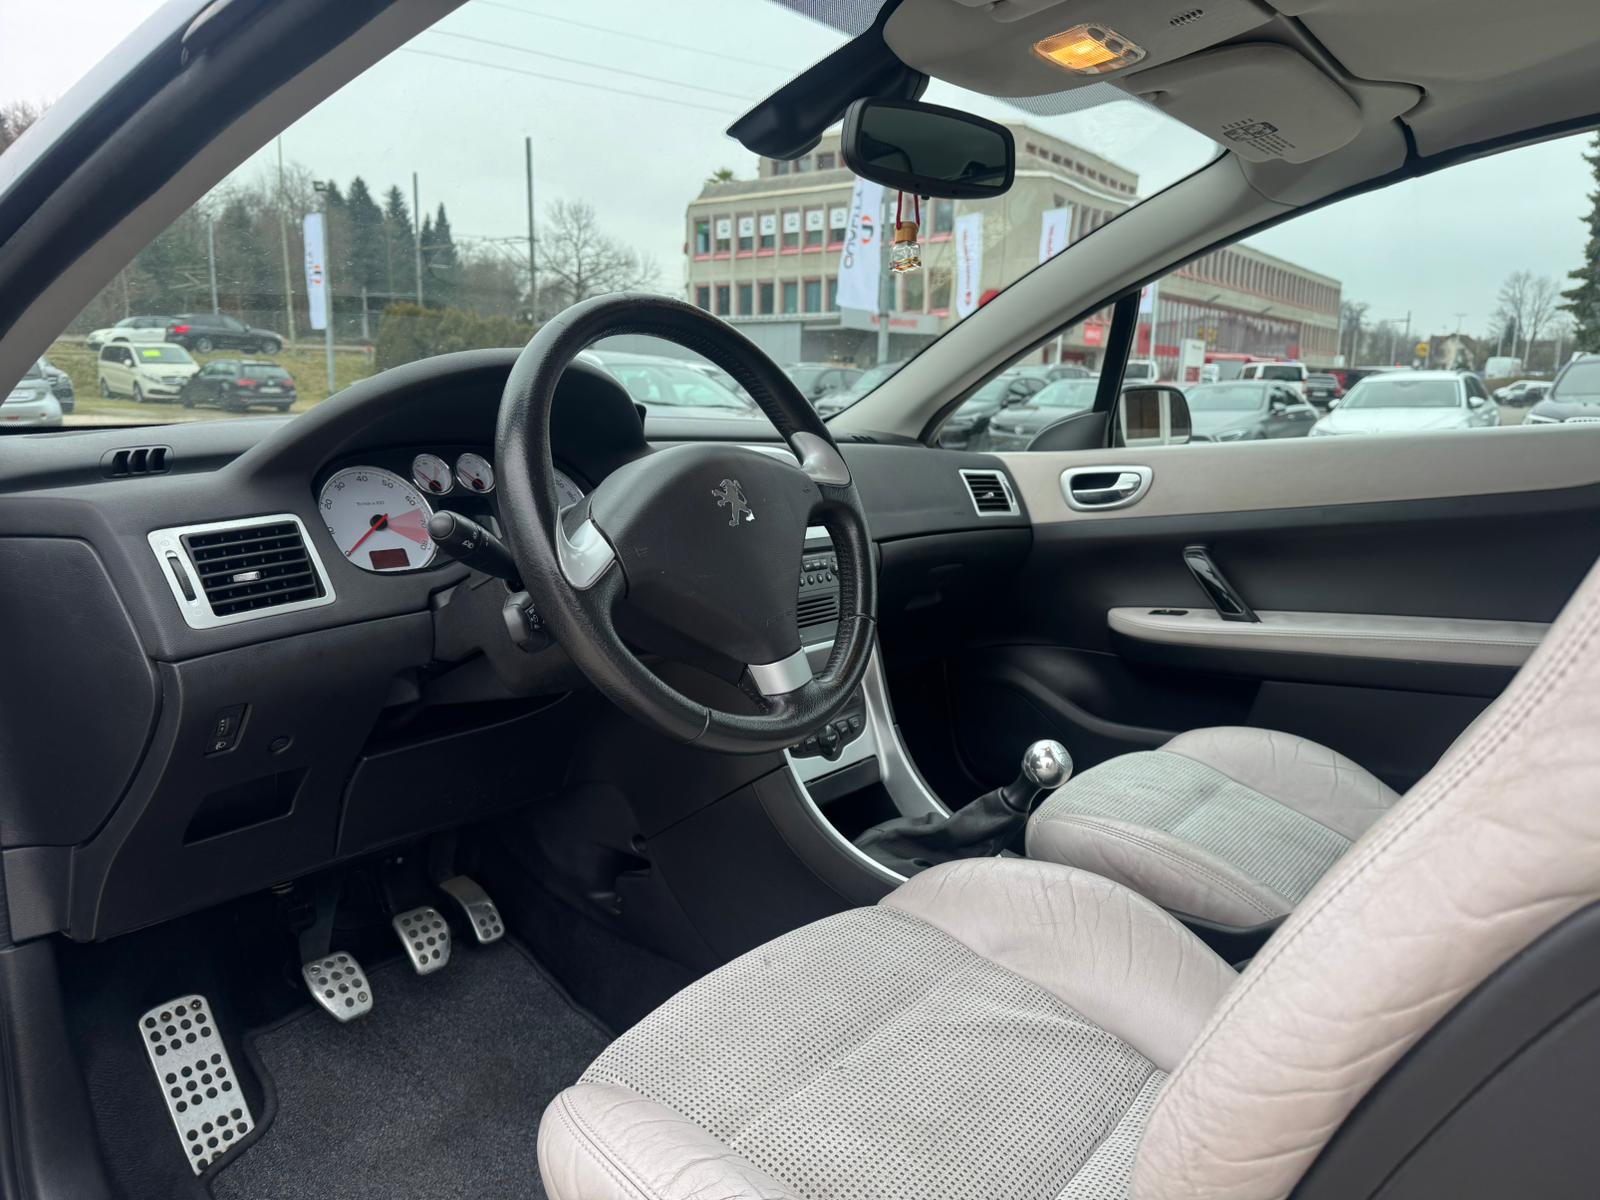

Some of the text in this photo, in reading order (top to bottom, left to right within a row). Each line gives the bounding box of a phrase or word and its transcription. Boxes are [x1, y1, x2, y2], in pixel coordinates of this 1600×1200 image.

[356, 475, 368, 483] 40
[382, 479, 394, 489] 50
[334, 481, 346, 492] 30
[324, 498, 333, 511] 20
[405, 495, 416, 506] 60
